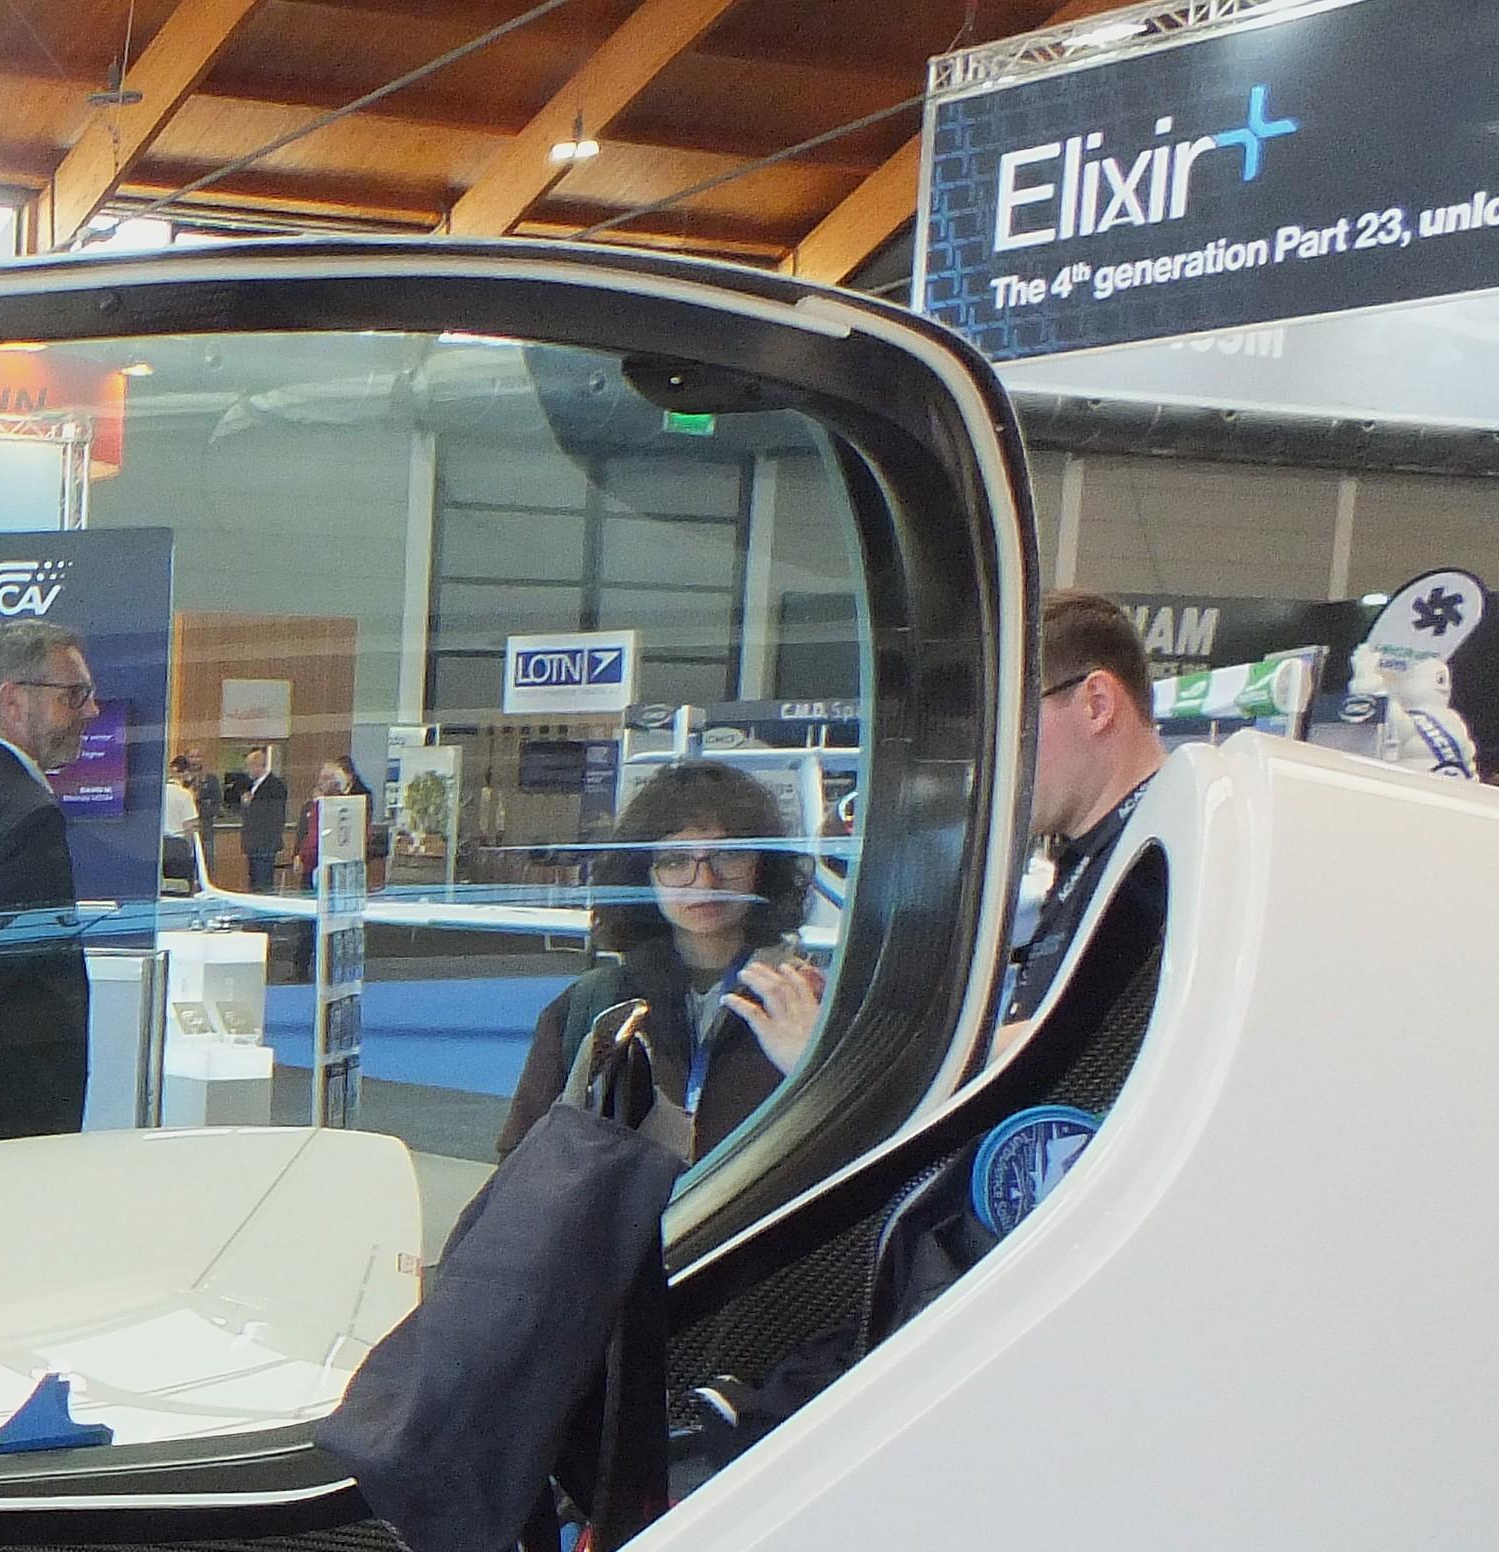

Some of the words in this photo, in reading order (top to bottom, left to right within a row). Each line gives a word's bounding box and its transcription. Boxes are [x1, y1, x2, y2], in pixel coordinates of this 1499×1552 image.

[989, 274, 1046, 310] The
[1050, 261, 1092, 299] 4th
[1093, 238, 1268, 300] generation
[1274, 217, 1350, 263] Part
[1354, 207, 1412, 247] 23,
